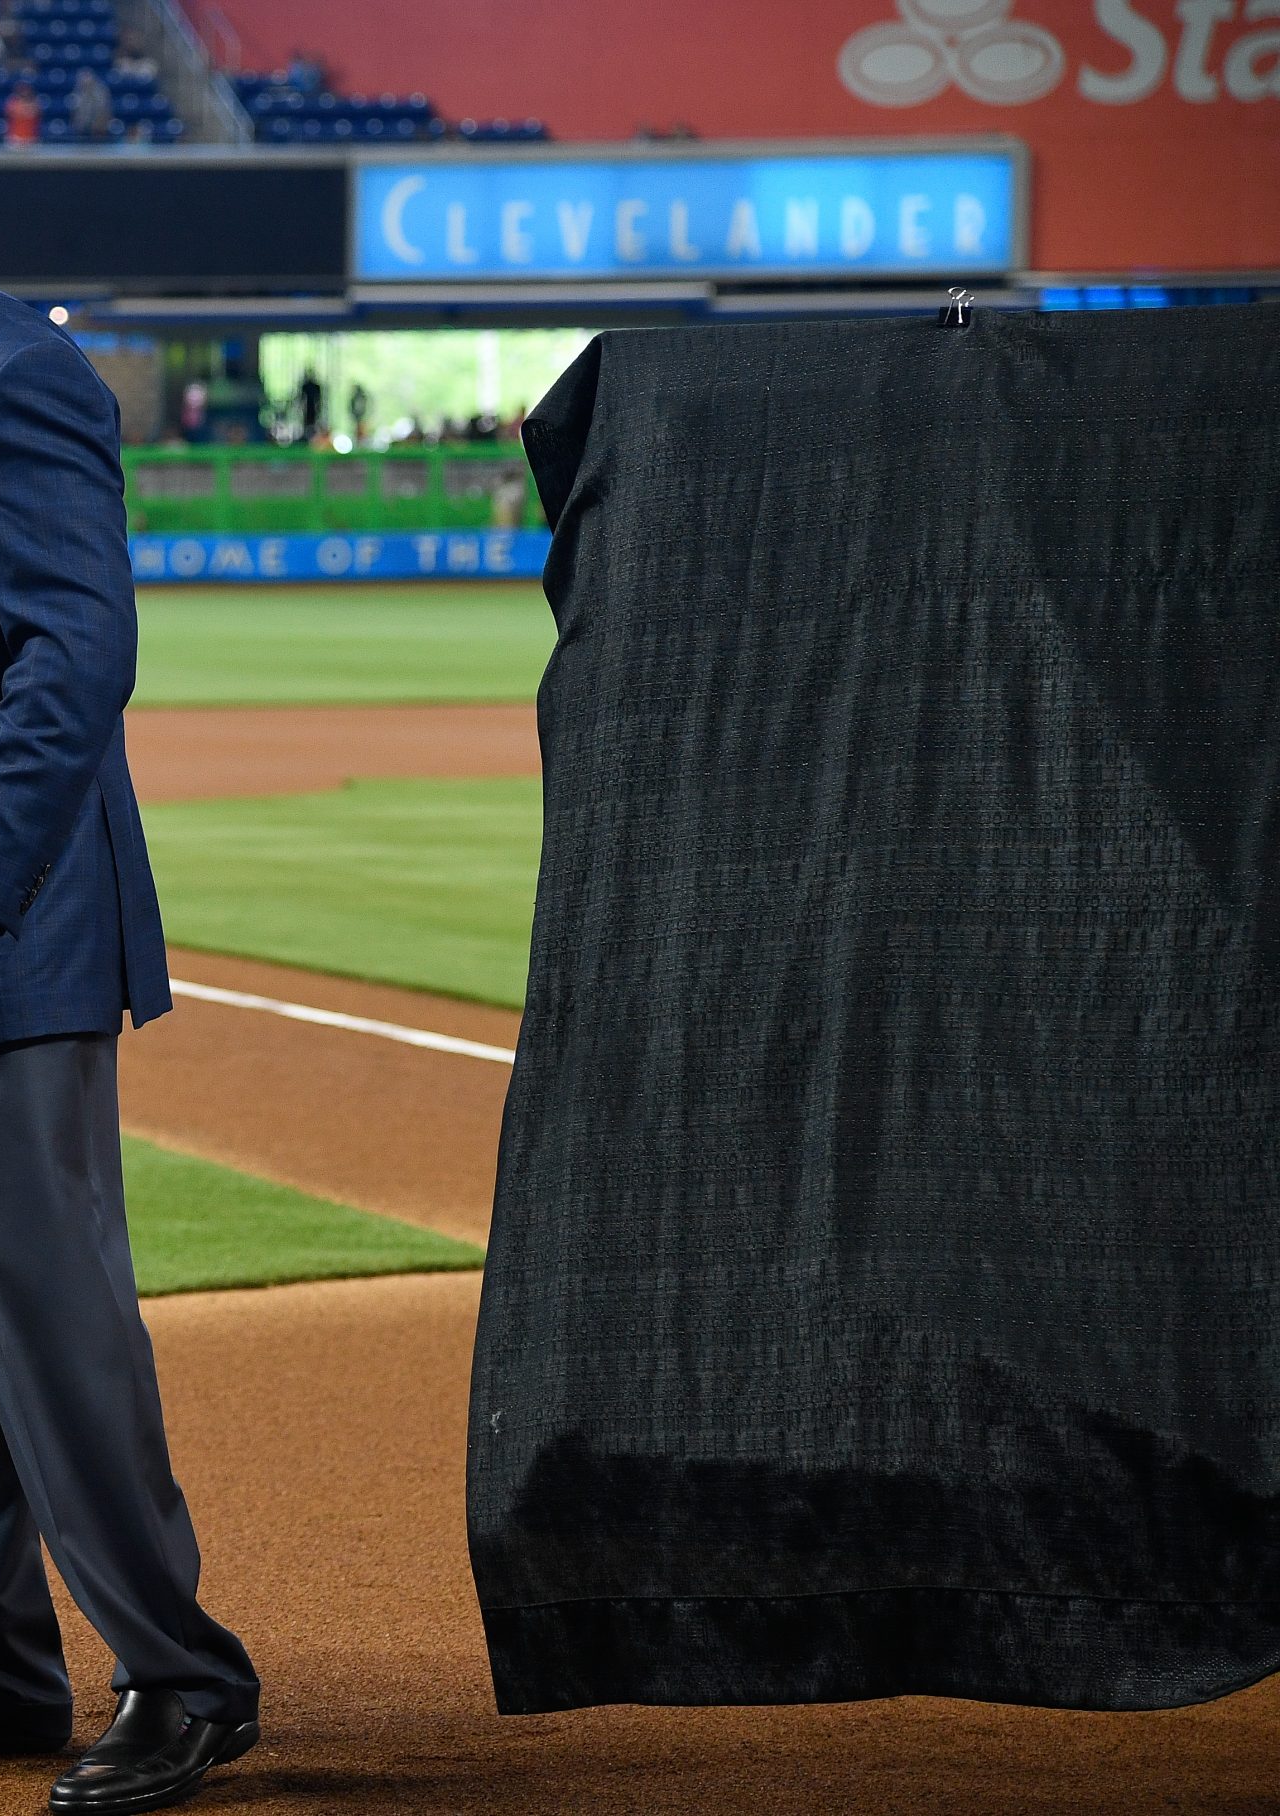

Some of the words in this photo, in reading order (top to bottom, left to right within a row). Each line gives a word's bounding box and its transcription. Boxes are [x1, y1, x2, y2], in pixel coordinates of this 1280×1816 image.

[381, 174, 988, 265] CLEVELANDER
[317, 535, 384, 577] OF
[412, 532, 518, 574] THE
